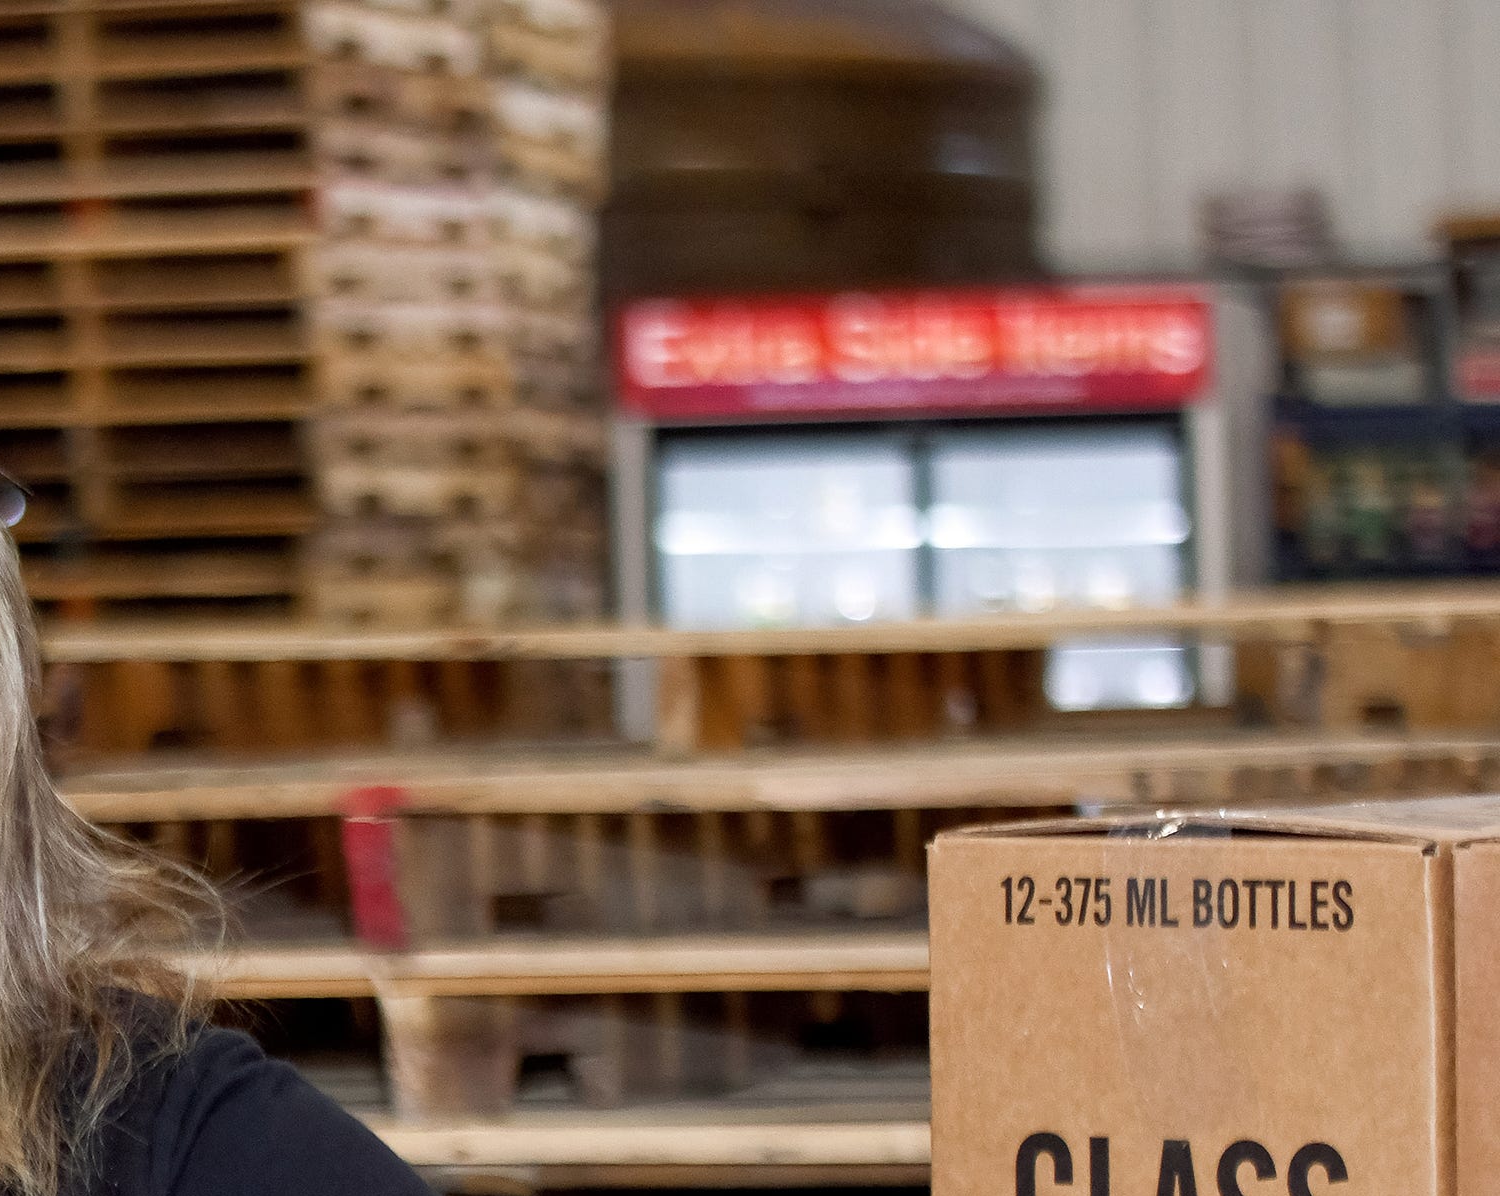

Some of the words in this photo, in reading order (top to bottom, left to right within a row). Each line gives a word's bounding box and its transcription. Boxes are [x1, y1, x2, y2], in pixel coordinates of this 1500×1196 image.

[1001, 876, 1112, 928] 12-375
[1126, 878, 1179, 929] ML
[1192, 879, 1355, 932] BOTTLES
